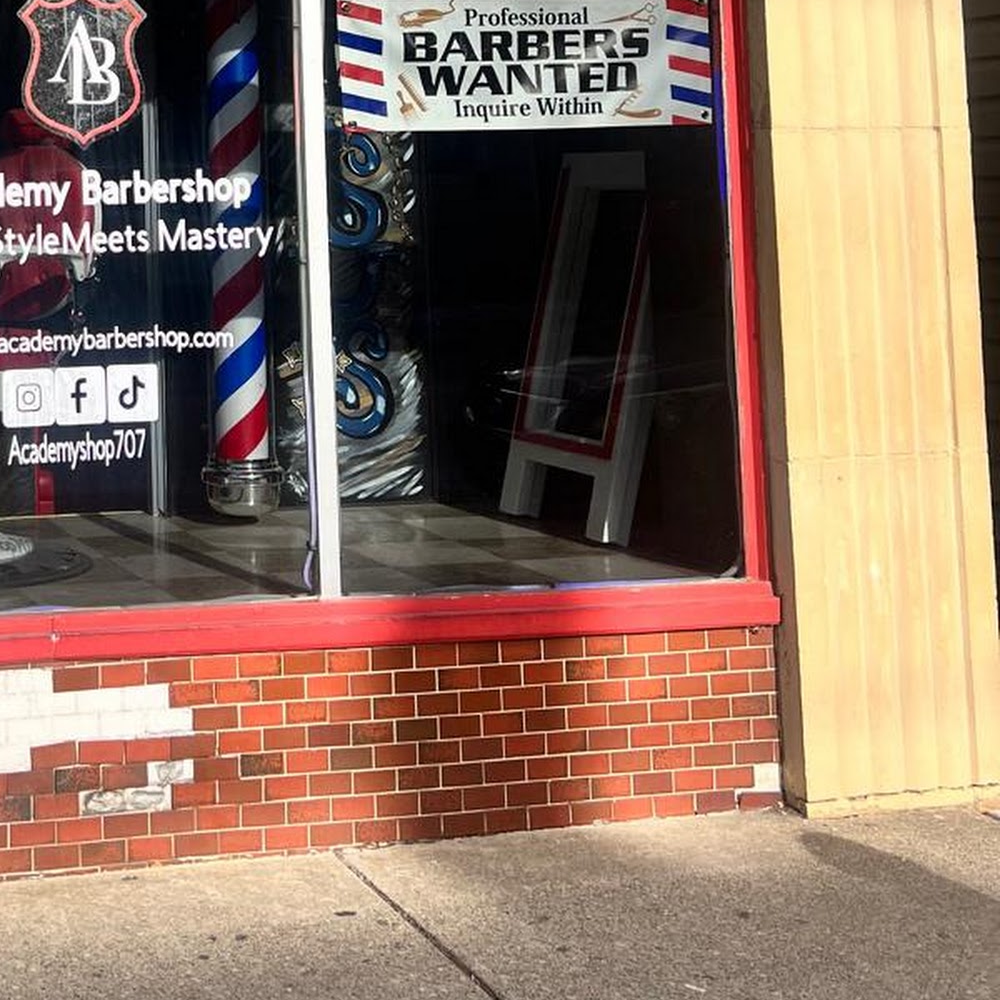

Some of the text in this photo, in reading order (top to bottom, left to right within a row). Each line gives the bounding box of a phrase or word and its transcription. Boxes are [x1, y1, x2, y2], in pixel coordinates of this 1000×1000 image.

[465, 6, 589, 28] Professional
[403, 28, 650, 63] BARBERS
[417, 62, 637, 96] WANTED
[455, 97, 603, 121] Inquire Within
[81, 168, 253, 208] Barbershop
[157, 217, 274, 258] Mastery
[7, 428, 146, 471] Academyshop707
